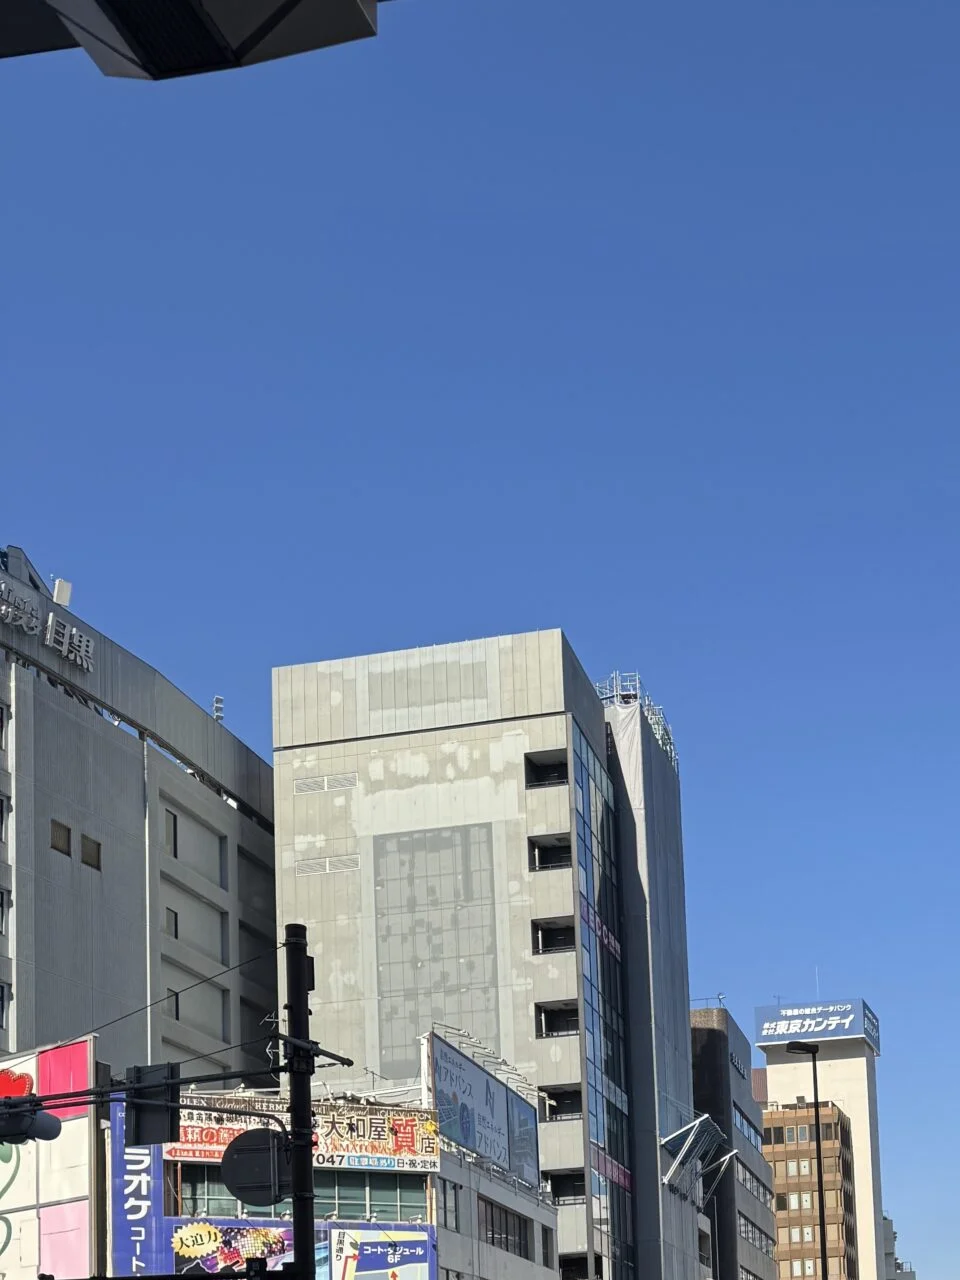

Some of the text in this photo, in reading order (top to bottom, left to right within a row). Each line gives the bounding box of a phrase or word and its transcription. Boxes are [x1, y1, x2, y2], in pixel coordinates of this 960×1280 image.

[776, 1014, 855, 1035] 東京カンテイ
[180, 1096, 207, 1107] OLEX
[312, 1154, 345, 1166] 047
[123, 1147, 152, 1220] ラオケ
[177, 1230, 219, 1252] 大迫力
